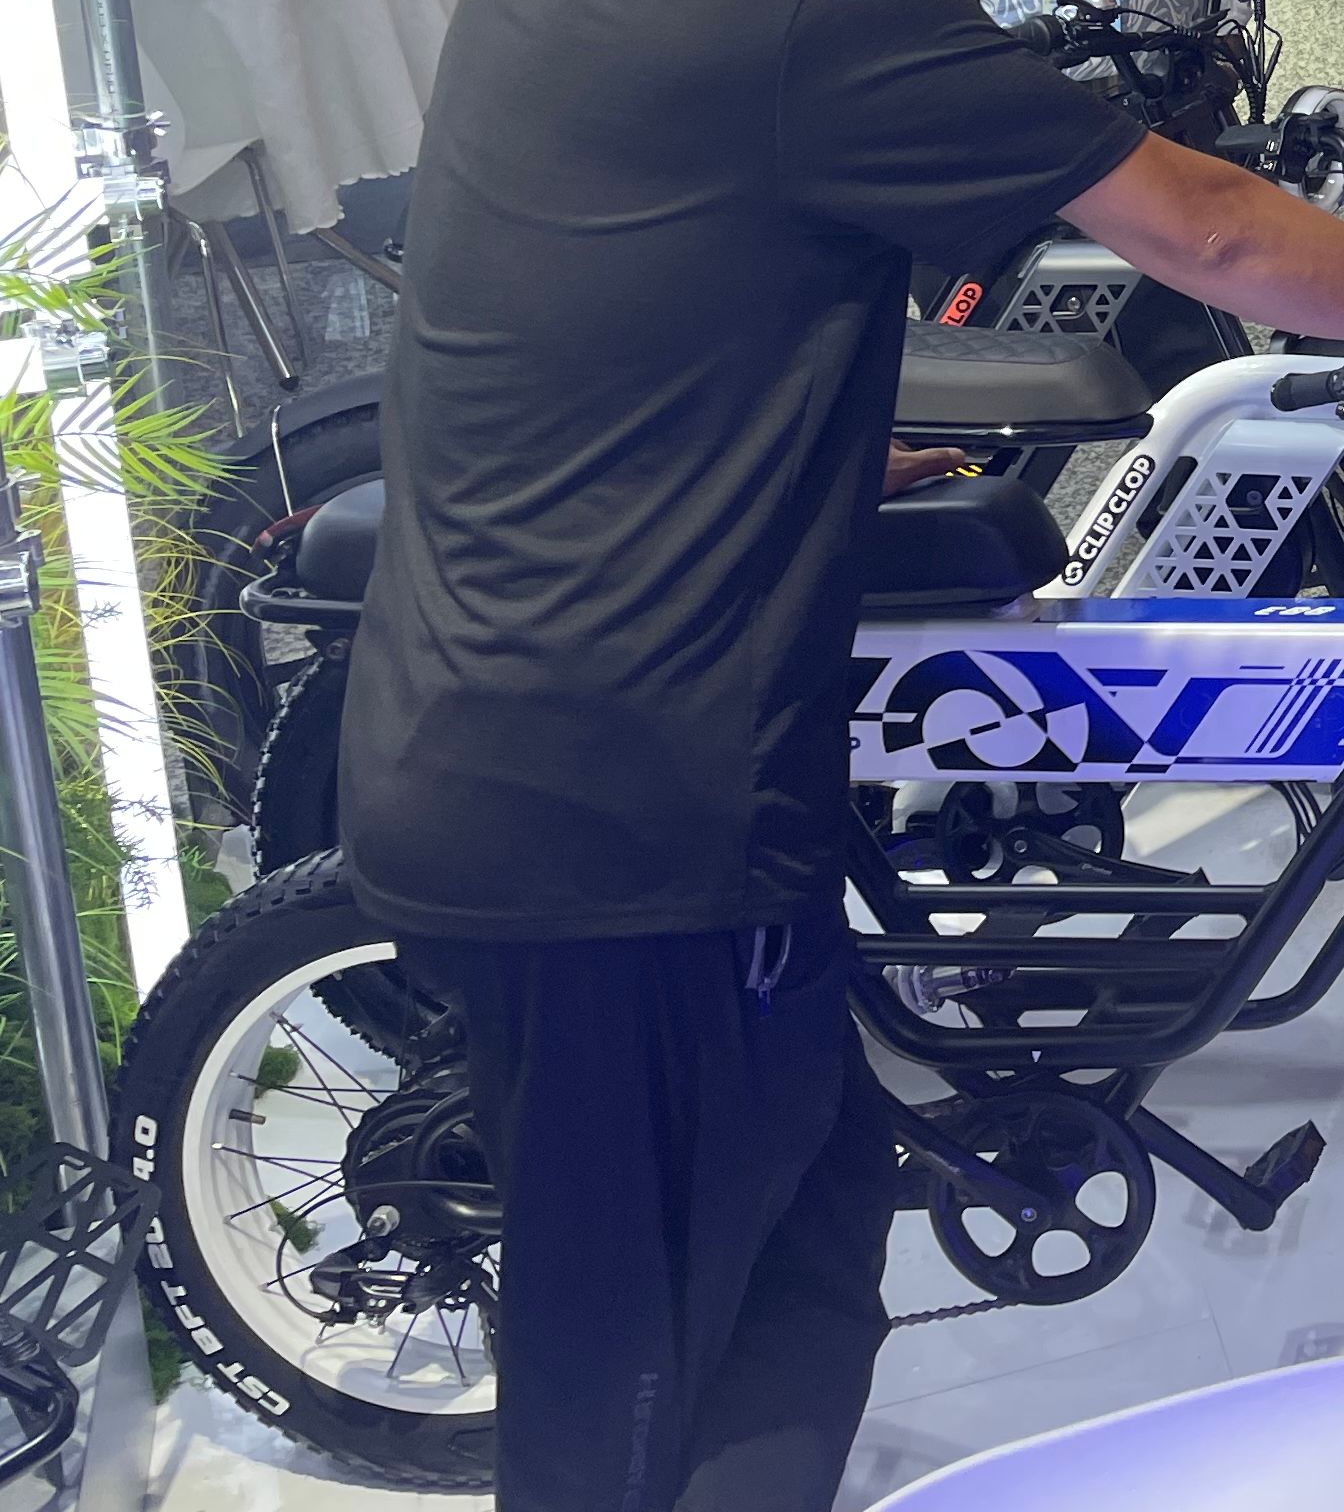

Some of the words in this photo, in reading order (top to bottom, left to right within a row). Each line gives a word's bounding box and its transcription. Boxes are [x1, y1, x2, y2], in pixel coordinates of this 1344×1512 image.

[132, 1114, 159, 1182] 4.0
[160, 1280, 225, 1356] BFT
[216, 1361, 291, 1417] CST
